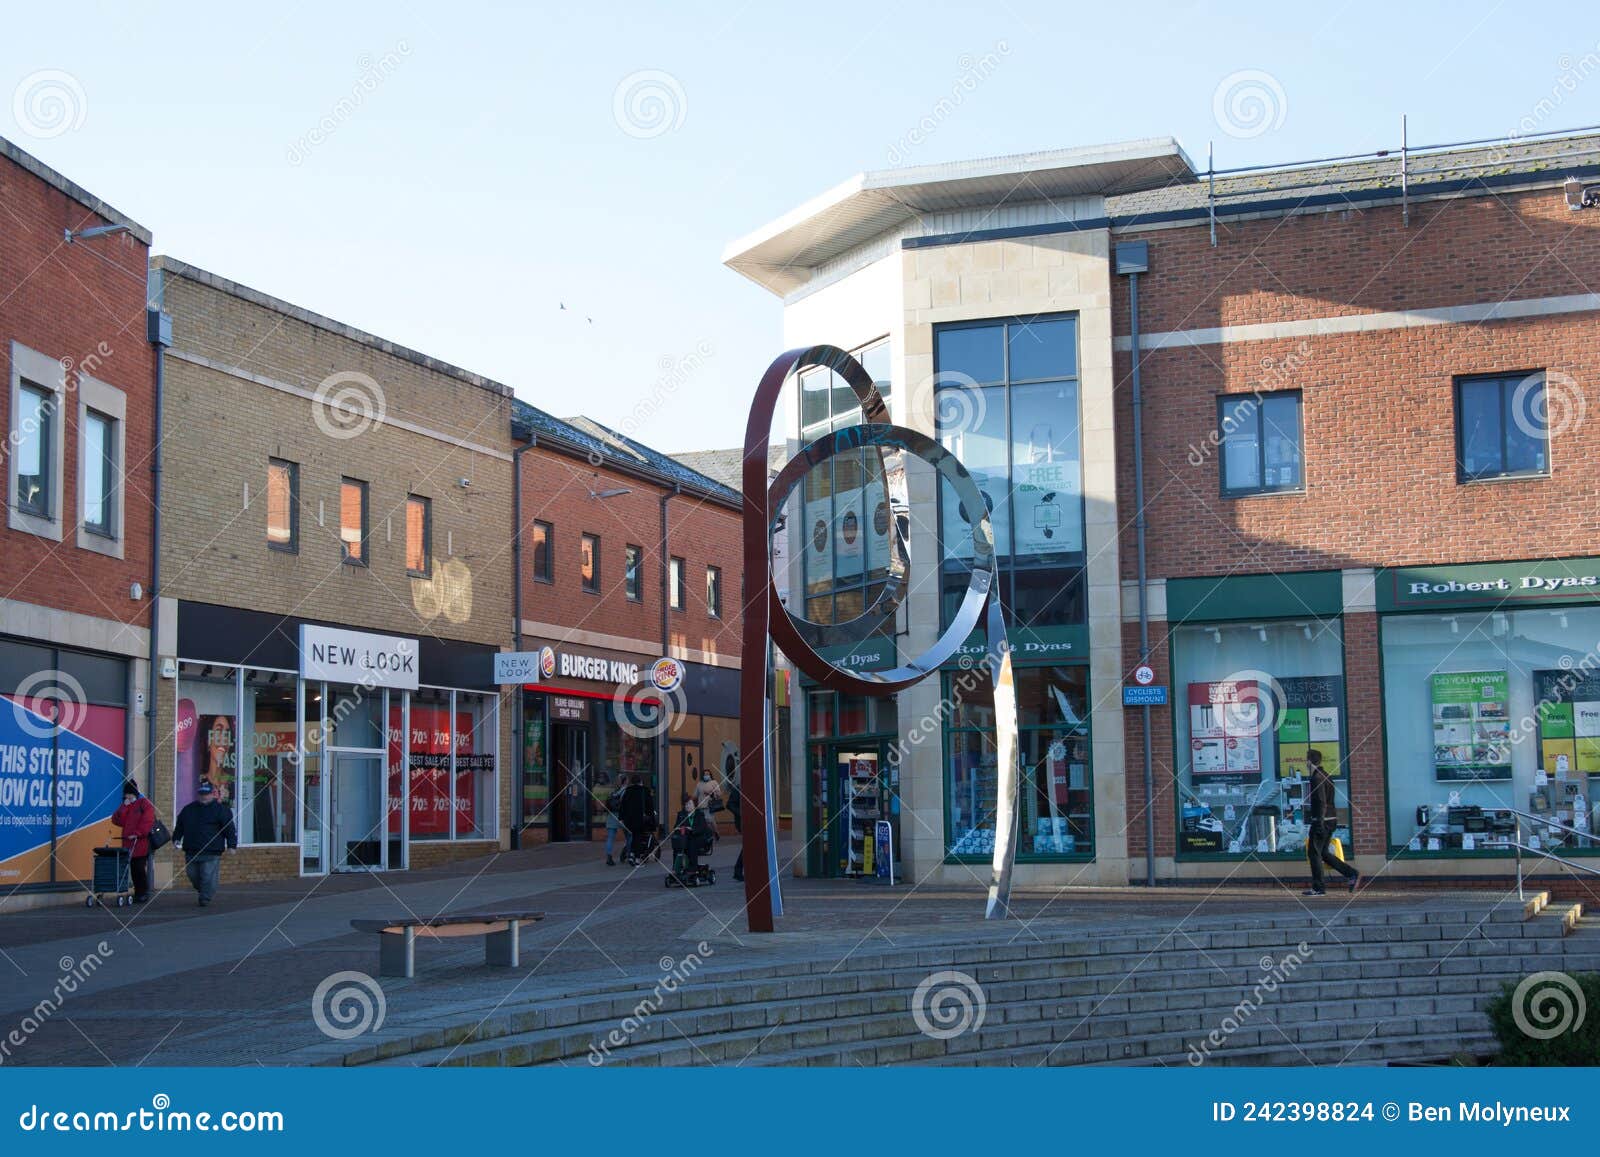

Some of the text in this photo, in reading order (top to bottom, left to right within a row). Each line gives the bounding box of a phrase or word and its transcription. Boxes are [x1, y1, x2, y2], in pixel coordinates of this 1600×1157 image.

[1028, 466, 1063, 482] FREE
[1408, 575, 1598, 595] Robert Dyas
[1024, 642, 1073, 653] Dyas
[312, 642, 414, 674] NEW LOOK
[501, 659, 529, 667] NEW
[850, 653, 880, 666] Dyas
[499, 669, 533, 678] LOOK
[561, 653, 608, 681] BURGER
[610, 660, 639, 685] KING
[656, 668, 677, 684] KING
[1451, 676, 1470, 684] YOU
[1471, 675, 1505, 684] KNOW?
[1125, 695, 1164, 703] DISMOUNT
[1208, 694, 1239, 703] SALE
[1548, 713, 1566, 721] Free
[1580, 710, 1599, 718] Free
[76, 750, 91, 777] IS
[409, 755, 424, 765] BEST
